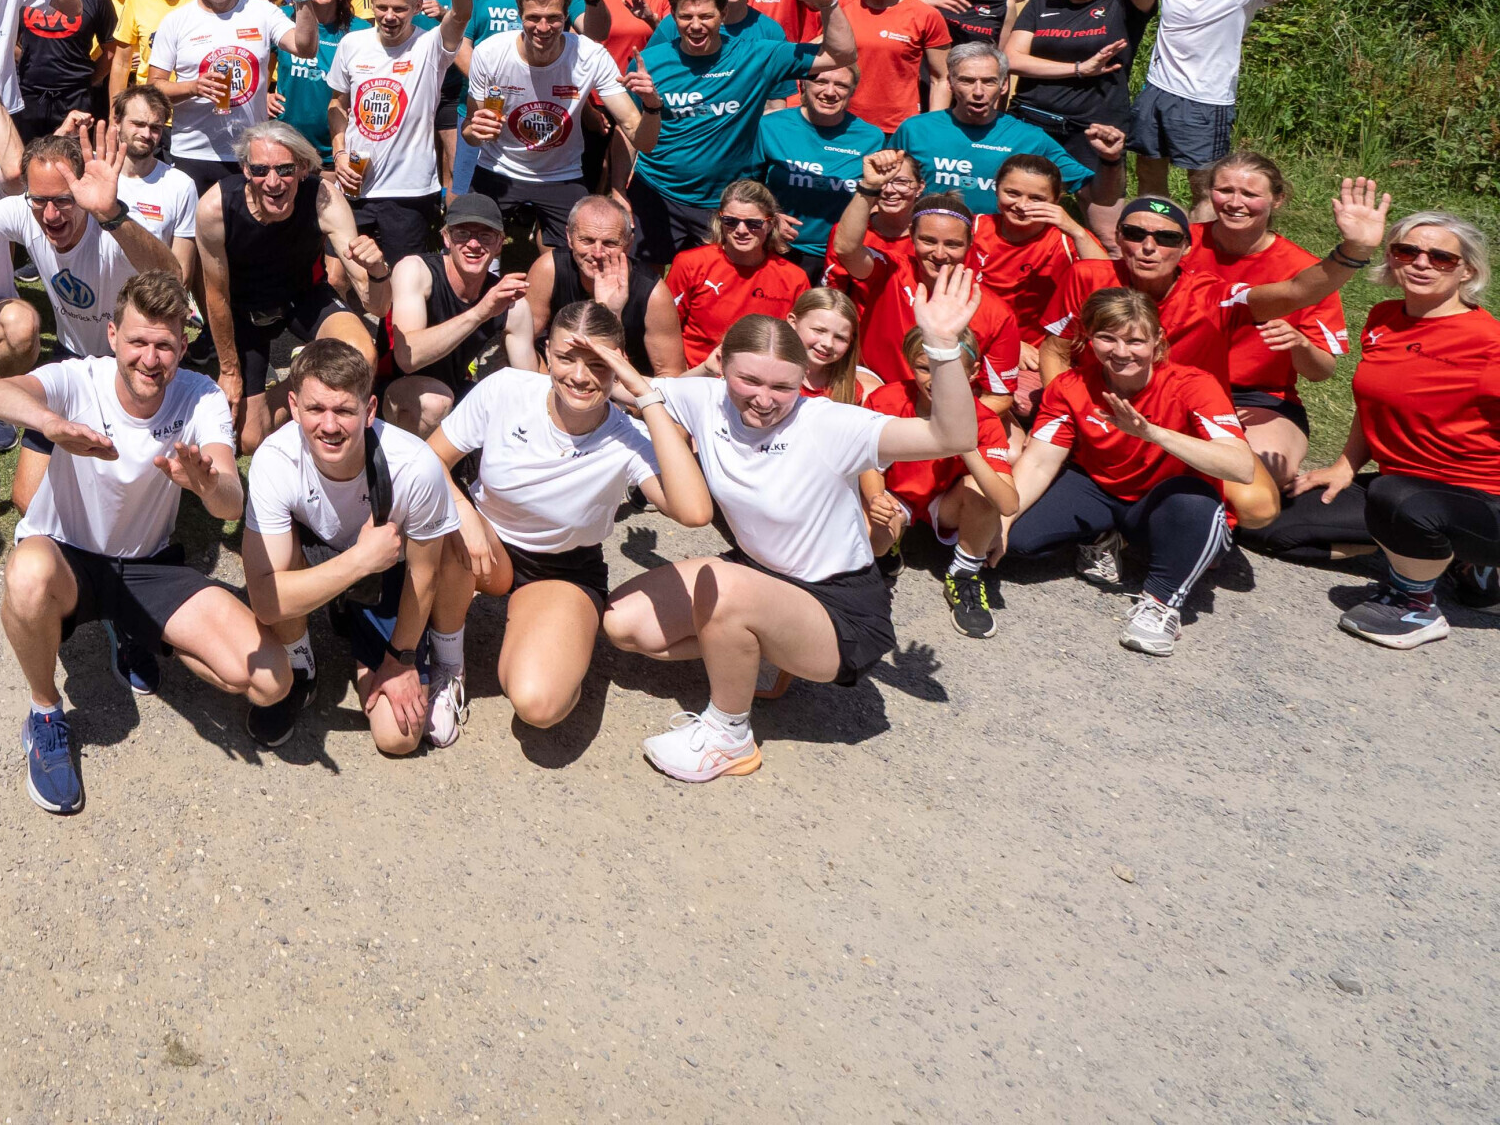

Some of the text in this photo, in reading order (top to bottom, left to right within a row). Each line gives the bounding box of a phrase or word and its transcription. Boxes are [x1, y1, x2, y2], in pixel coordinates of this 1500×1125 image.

[488, 6, 518, 20] we
[961, 22, 993, 36] rennt
[1073, 25, 1108, 38] rennt
[370, 91, 392, 101] Jede
[664, 91, 703, 106] we
[363, 99, 390, 113] Oma
[530, 112, 554, 123] Jede
[523, 119, 554, 130] Oma
[823, 144, 861, 156] concentrix
[971, 142, 1013, 153] concentrix
[786, 158, 824, 175] we
[934, 156, 973, 173] we
